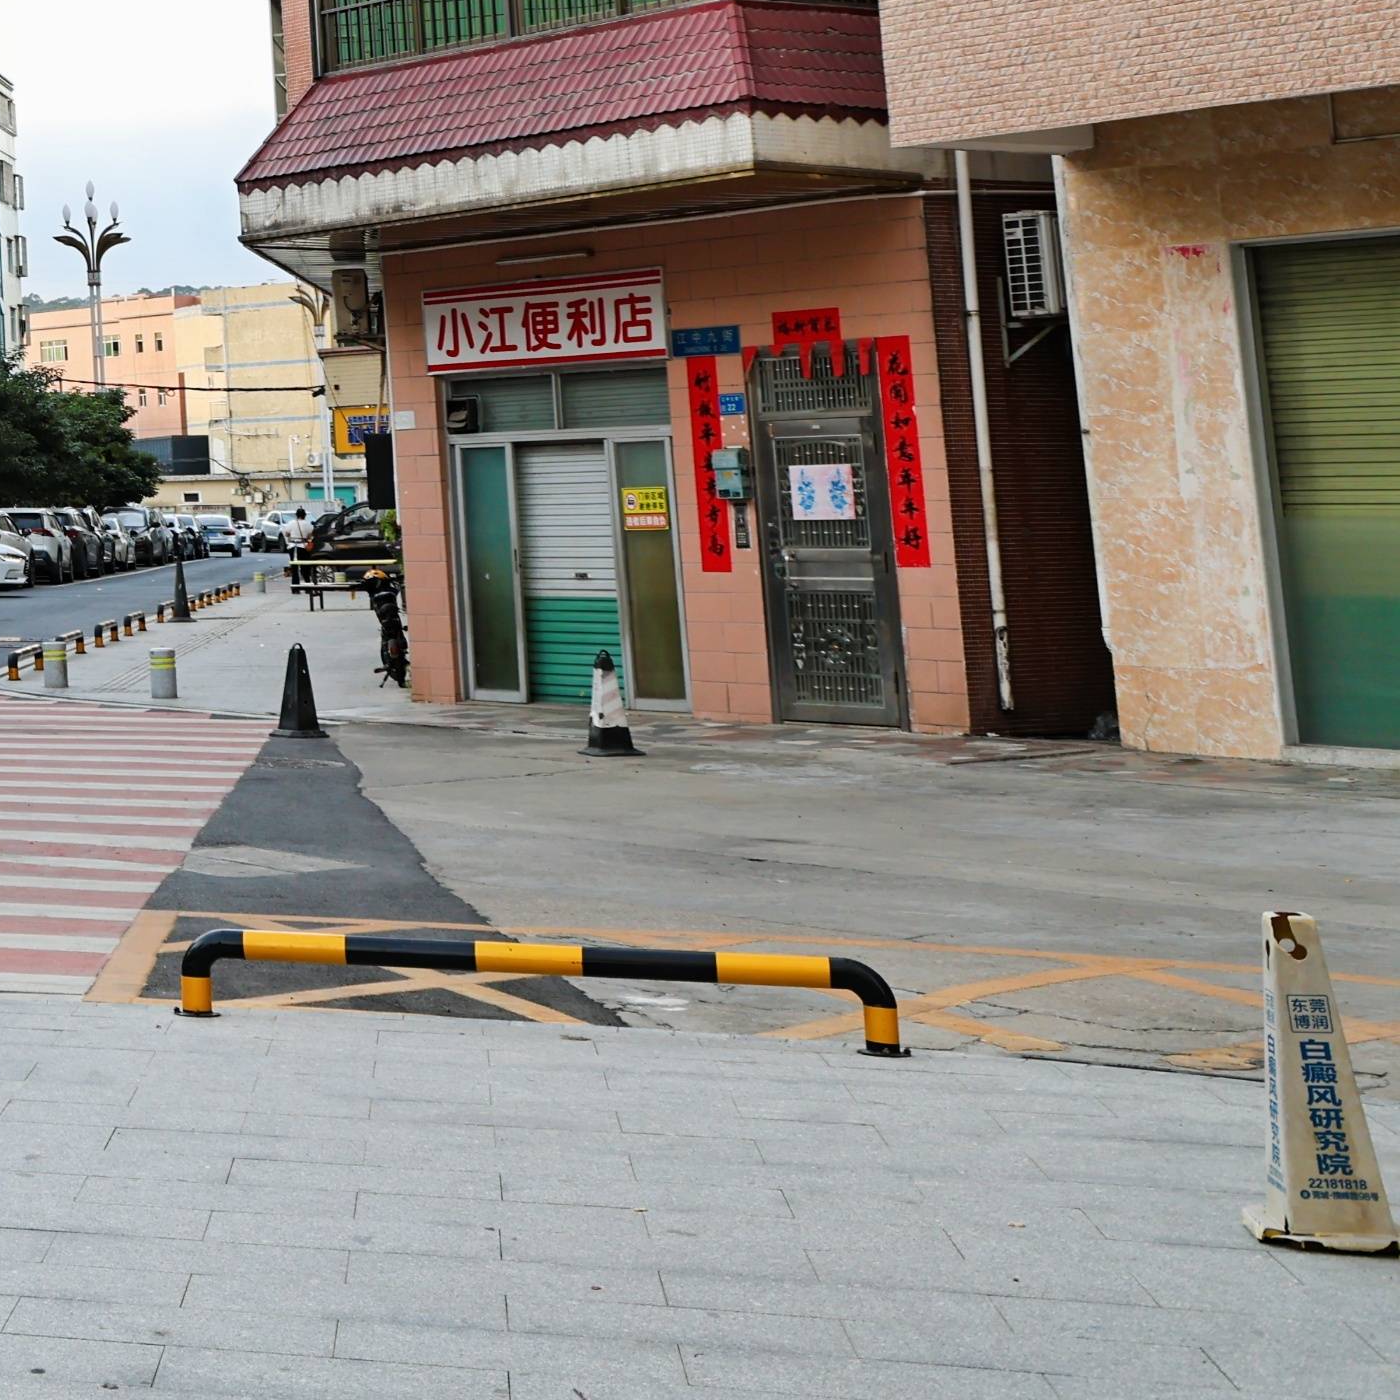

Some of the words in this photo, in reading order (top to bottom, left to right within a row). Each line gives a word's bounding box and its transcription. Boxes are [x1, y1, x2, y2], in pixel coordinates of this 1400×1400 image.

[436, 292, 654, 358] 小江便利店
[1291, 998, 1327, 1014] 东莞
[1294, 1014, 1329, 1030] 博润
[1299, 1038, 1354, 1176] 白癜风研究院
[1308, 1178, 1368, 1191] 22181818
